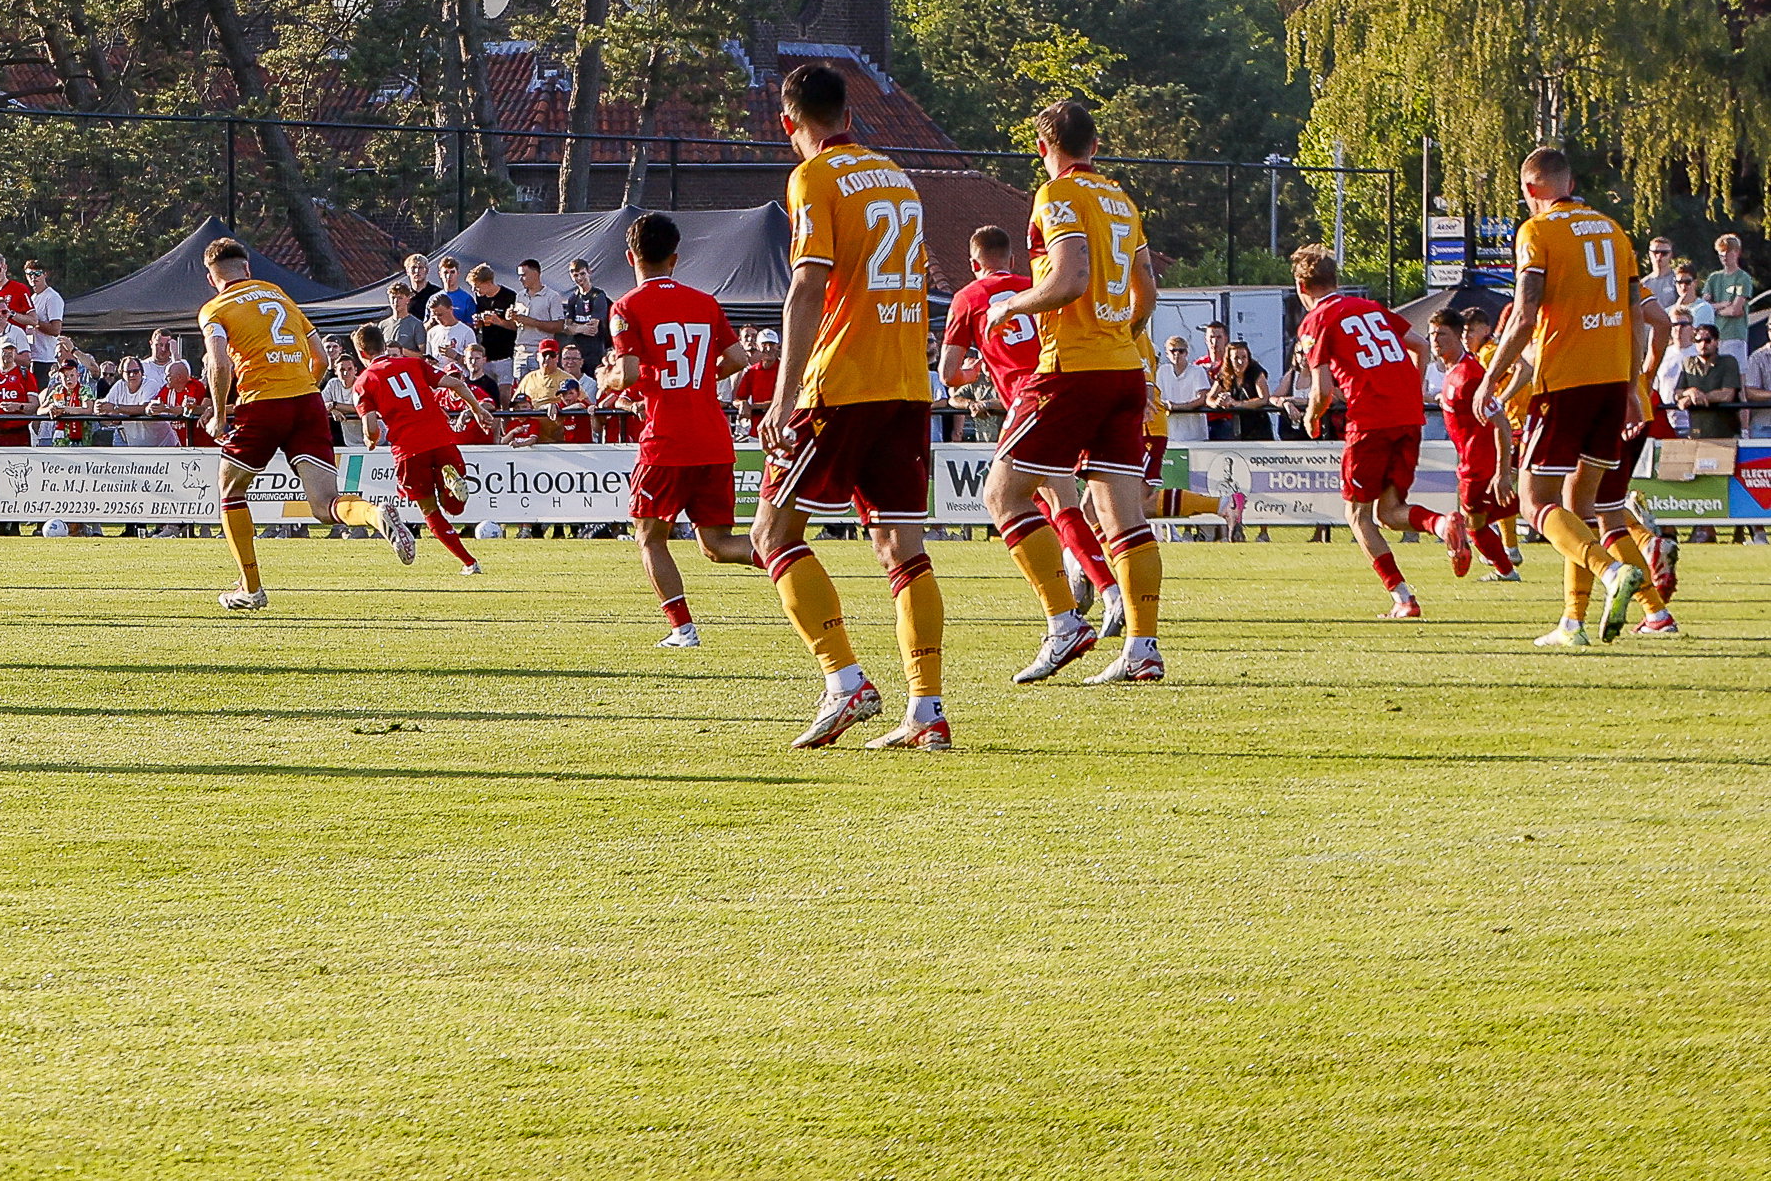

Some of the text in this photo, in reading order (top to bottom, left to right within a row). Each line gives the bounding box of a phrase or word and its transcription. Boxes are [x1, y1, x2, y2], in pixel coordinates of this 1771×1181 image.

[864, 199, 924, 291] 22
[1107, 222, 1131, 296] 5
[1583, 239, 1617, 302] 4
[258, 301, 295, 345] 2
[1339, 310, 1406, 370] 35
[653, 321, 711, 390] 37
[386, 371, 423, 411] 4
[41, 461, 169, 475] Vee- en Varkenshandel
[1250, 454, 1304, 467] apparatuur
[1306, 455, 1328, 464] voor
[41, 479, 174, 494] Fa. M.J. Leusink & Zn.
[271, 473, 303, 490] Do
[1269, 472, 1311, 490] HOH
[247, 492, 294, 502] TOURINGCAR
[0, 500, 21, 514] Tel.
[104, 501, 144, 516] 292565
[150, 501, 215, 516] BENTELO
[1254, 499, 1315, 514] Gerry Pot
